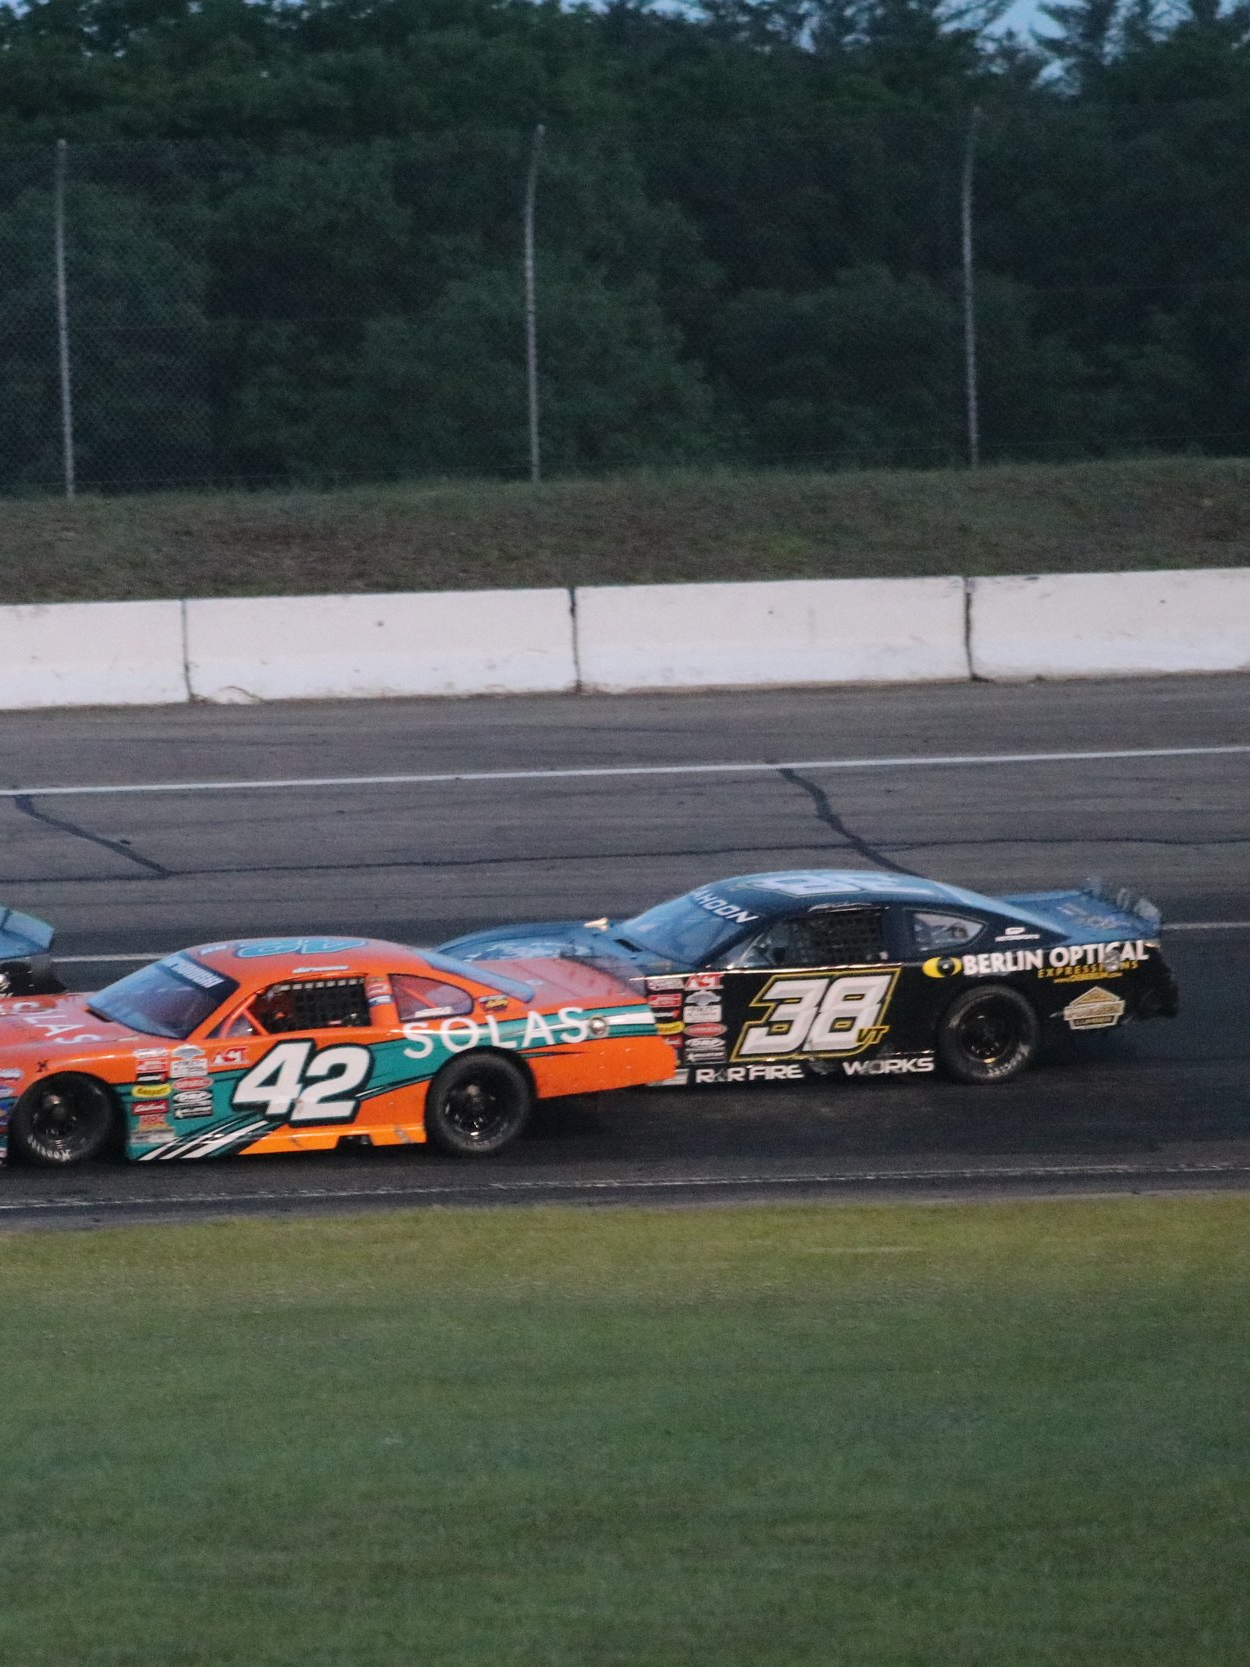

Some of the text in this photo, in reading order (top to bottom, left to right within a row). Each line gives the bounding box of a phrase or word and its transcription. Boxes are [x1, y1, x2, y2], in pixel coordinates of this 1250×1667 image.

[961, 940, 1150, 976] BERLIN OPTICAL
[1037, 960, 1139, 979] EXPRESSINS
[730, 967, 901, 1062] 38
[402, 1007, 590, 1059] SOLAS
[233, 1039, 372, 1128] 42
[748, 1064, 805, 1082] FIRE
[842, 1056, 936, 1076] WORKS
